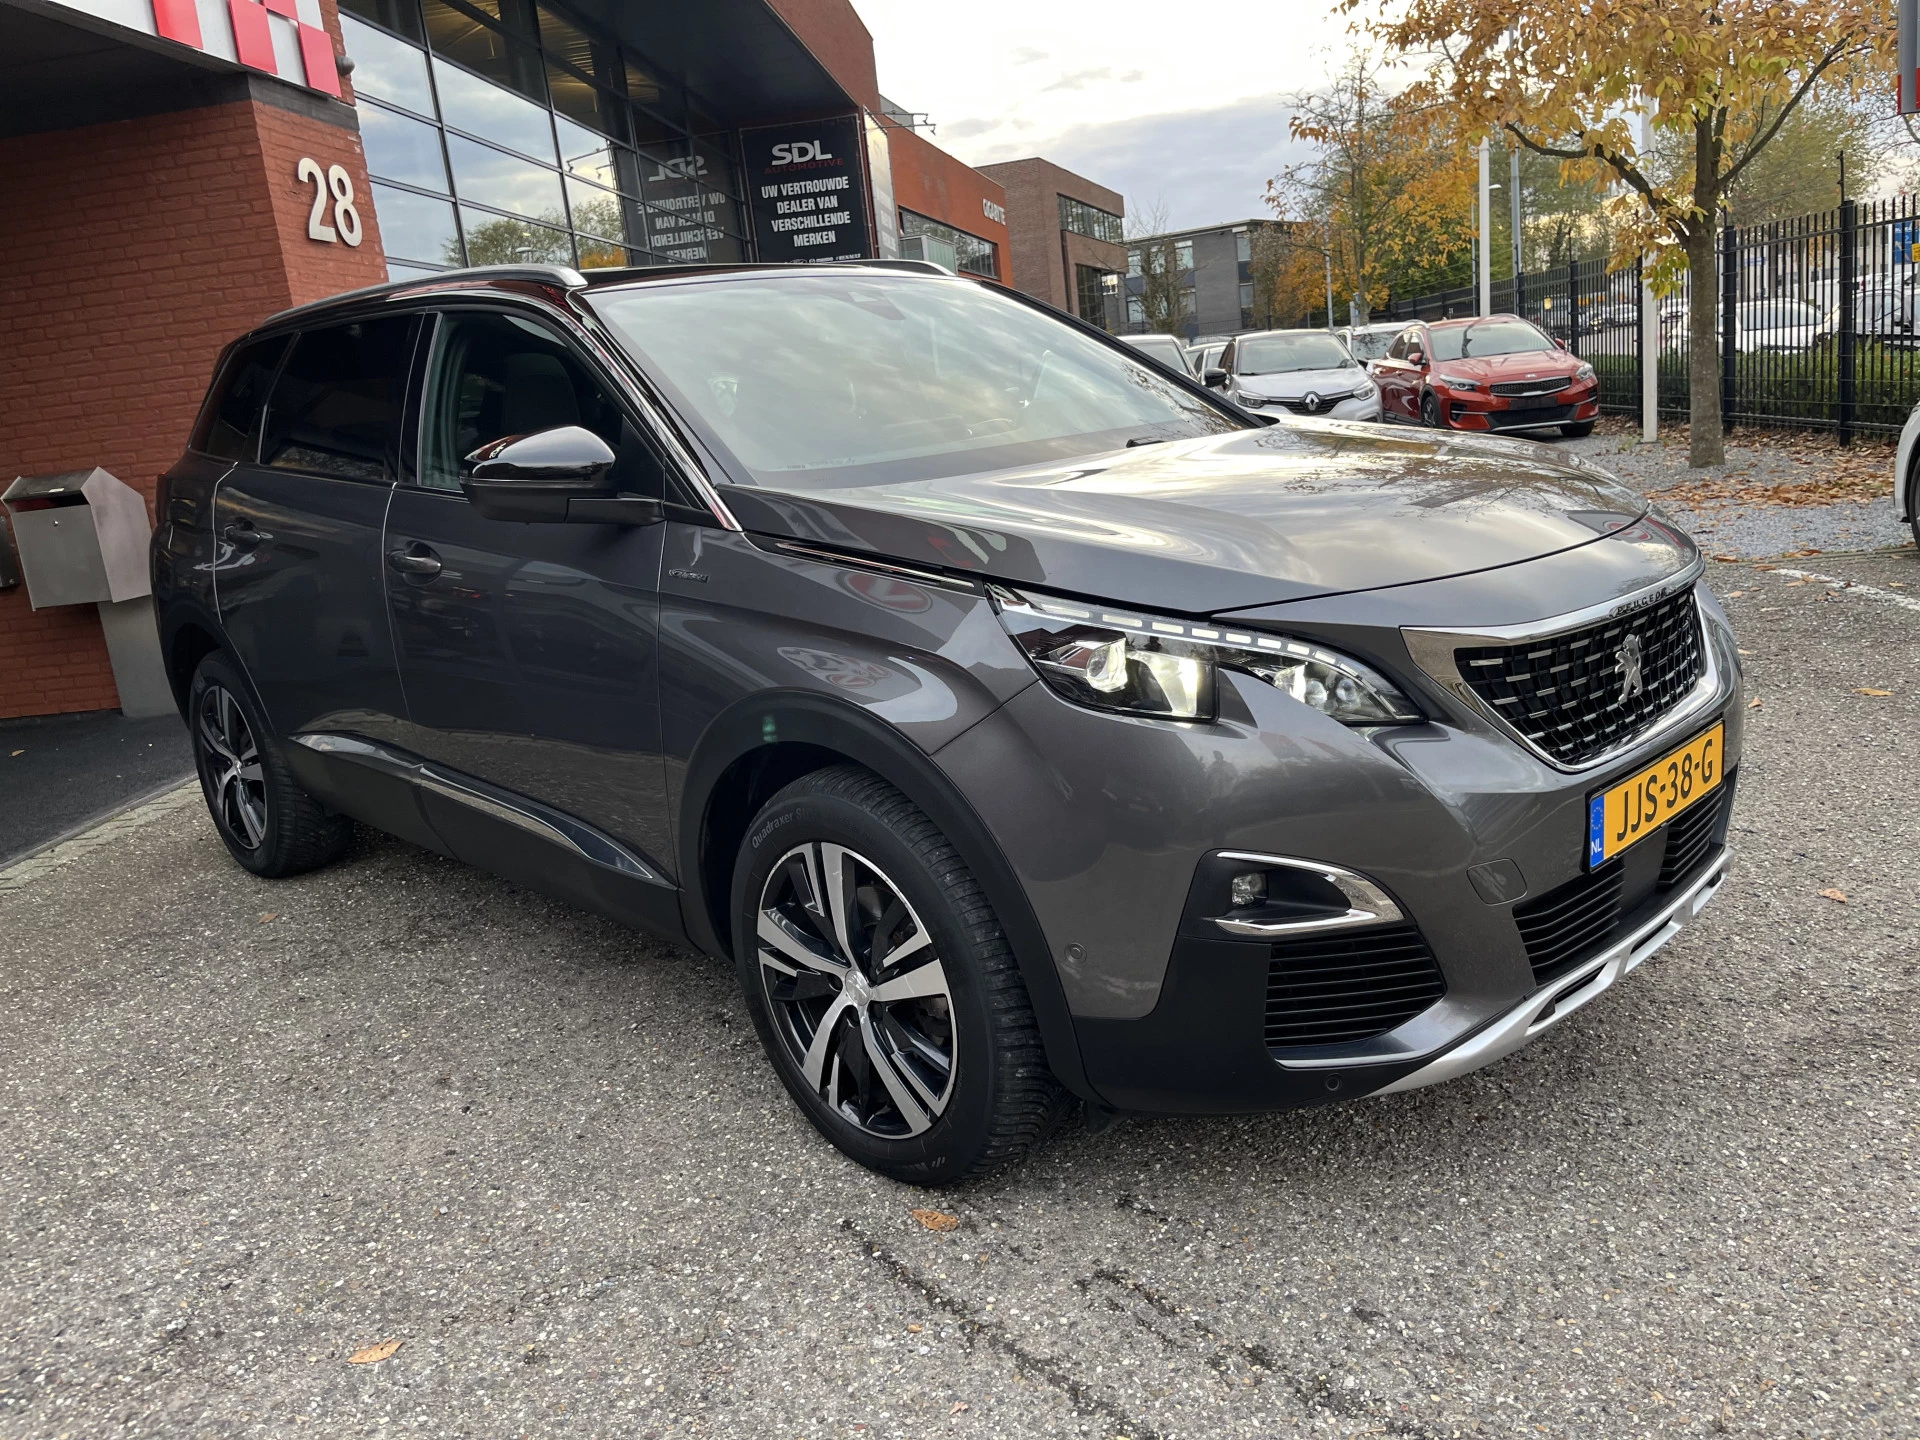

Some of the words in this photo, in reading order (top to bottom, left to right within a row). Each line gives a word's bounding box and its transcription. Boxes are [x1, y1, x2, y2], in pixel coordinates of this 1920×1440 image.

[771, 140, 832, 166] SDL
[764, 157, 844, 175] AUTOMOTIVE
[761, 184, 778, 199] UW
[780, 176, 849, 197] VERTROUWDE
[298, 157, 363, 247] 28
[777, 197, 815, 215] DEALER
[817, 195, 838, 210] VAN
[771, 211, 851, 233] VERSCHILLENDE
[793, 230, 836, 248] MERKEN
[1617, 738, 1713, 842] JJS-38-G
[751, 811, 794, 849] Quadraxer
[1590, 837, 1602, 855] NL
